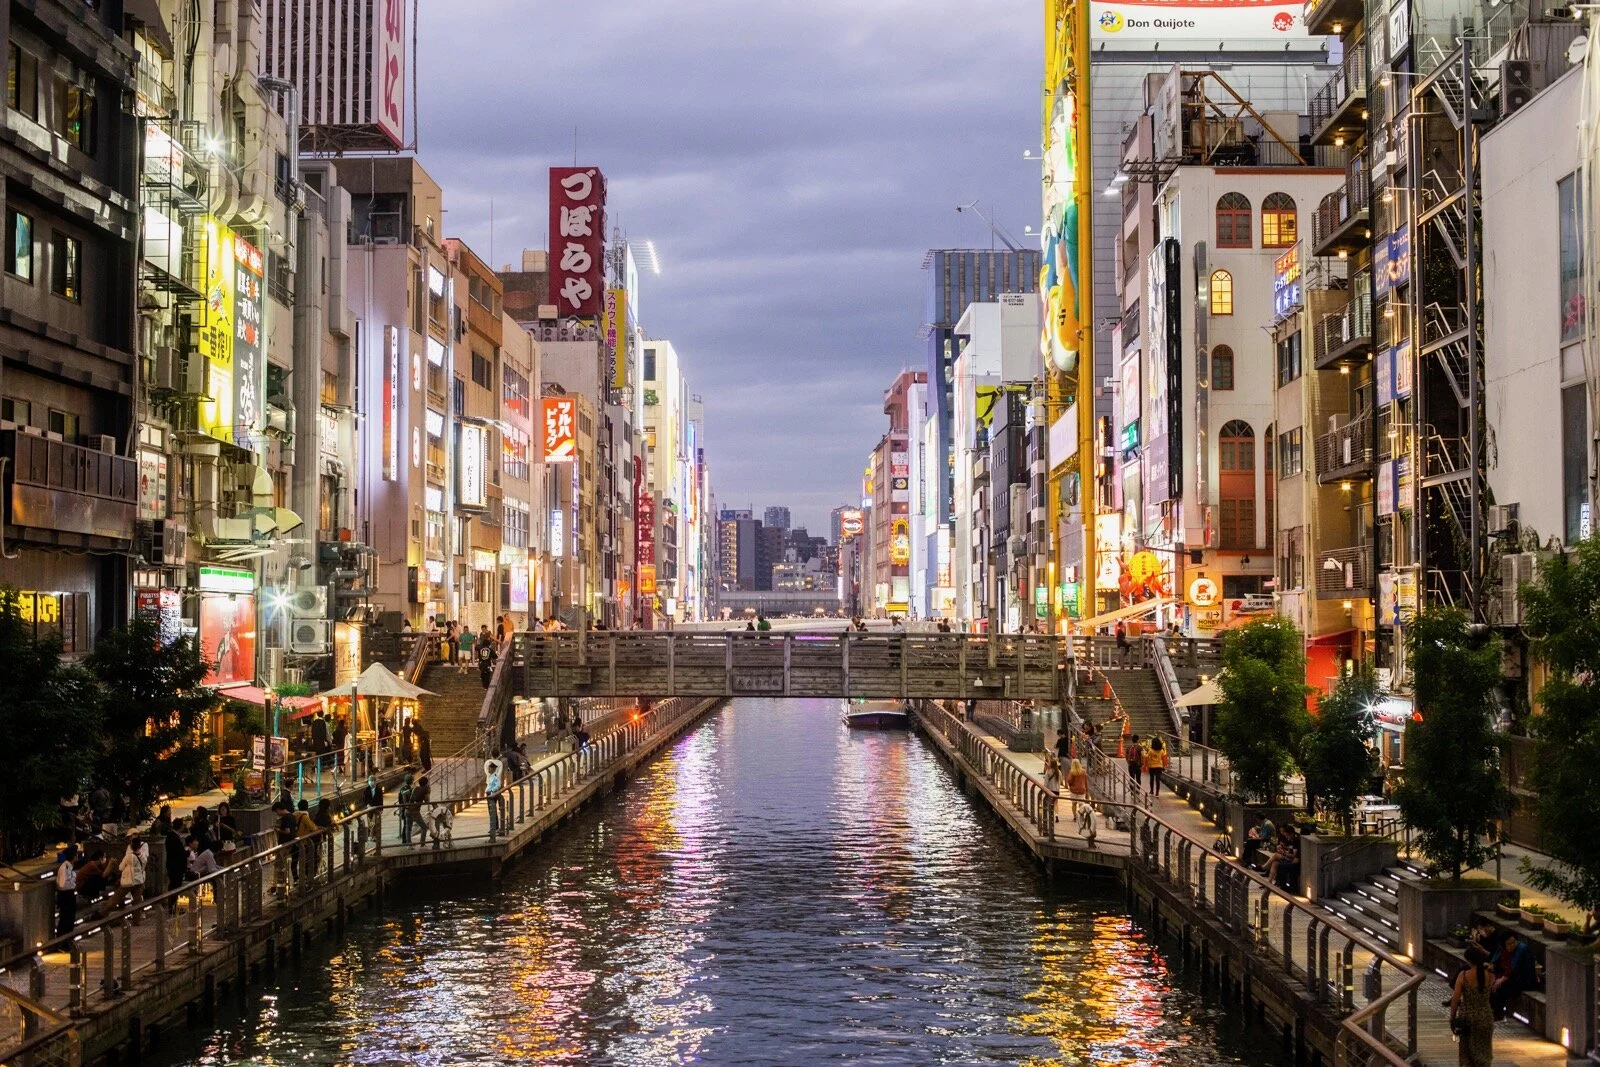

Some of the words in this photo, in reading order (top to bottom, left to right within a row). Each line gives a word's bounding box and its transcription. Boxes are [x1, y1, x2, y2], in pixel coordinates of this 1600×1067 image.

[1127, 19, 1150, 28] Don
[1153, 19, 1195, 29] Quijote
[560, 169, 597, 309] づぼらや
